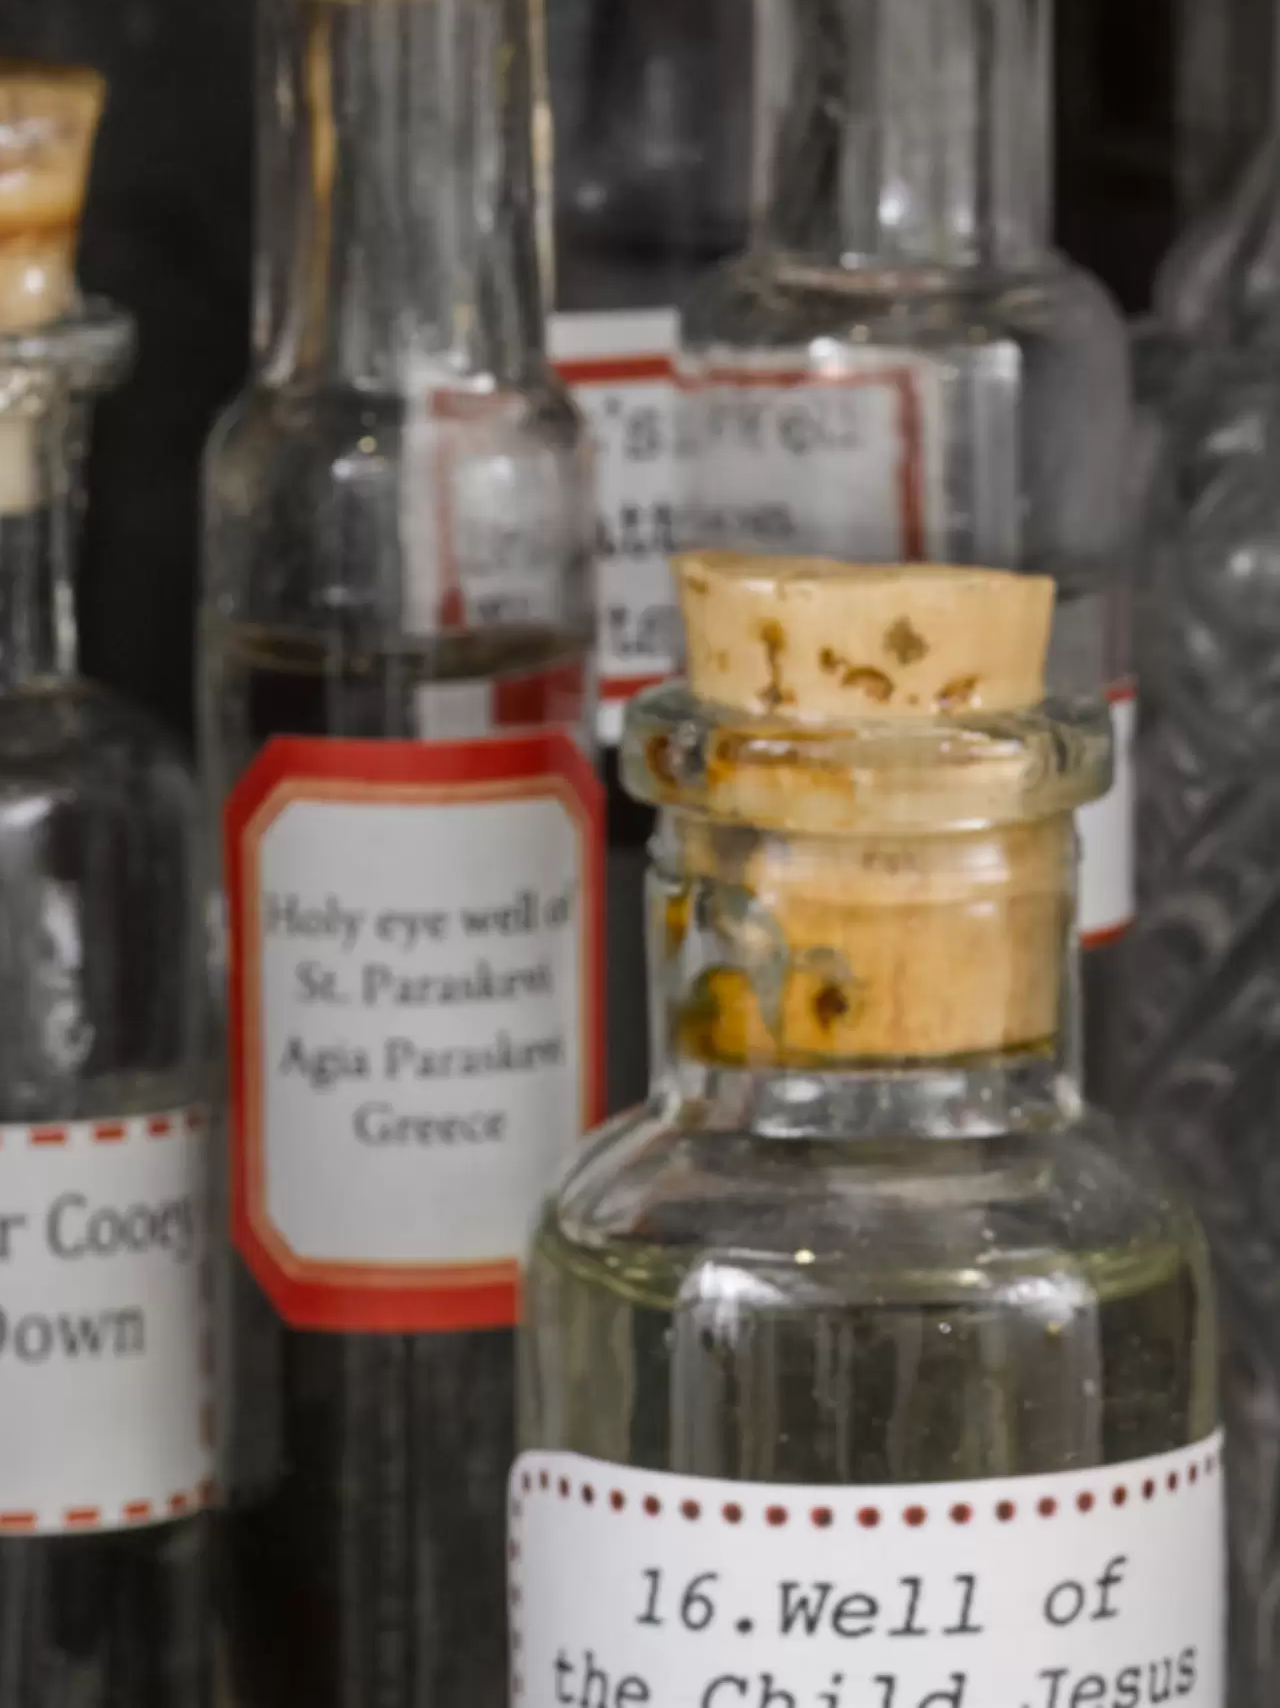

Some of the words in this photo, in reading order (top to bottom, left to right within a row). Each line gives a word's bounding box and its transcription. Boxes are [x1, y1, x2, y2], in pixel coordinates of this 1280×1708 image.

[295, 960, 347, 1005] St.
[352, 1101, 508, 1148] Greece
[1042, 1555, 1129, 1629] of
[552, 1649, 651, 1708] the
[700, 1673, 967, 1708] Child
[1023, 1646, 1197, 1708] Jesus
